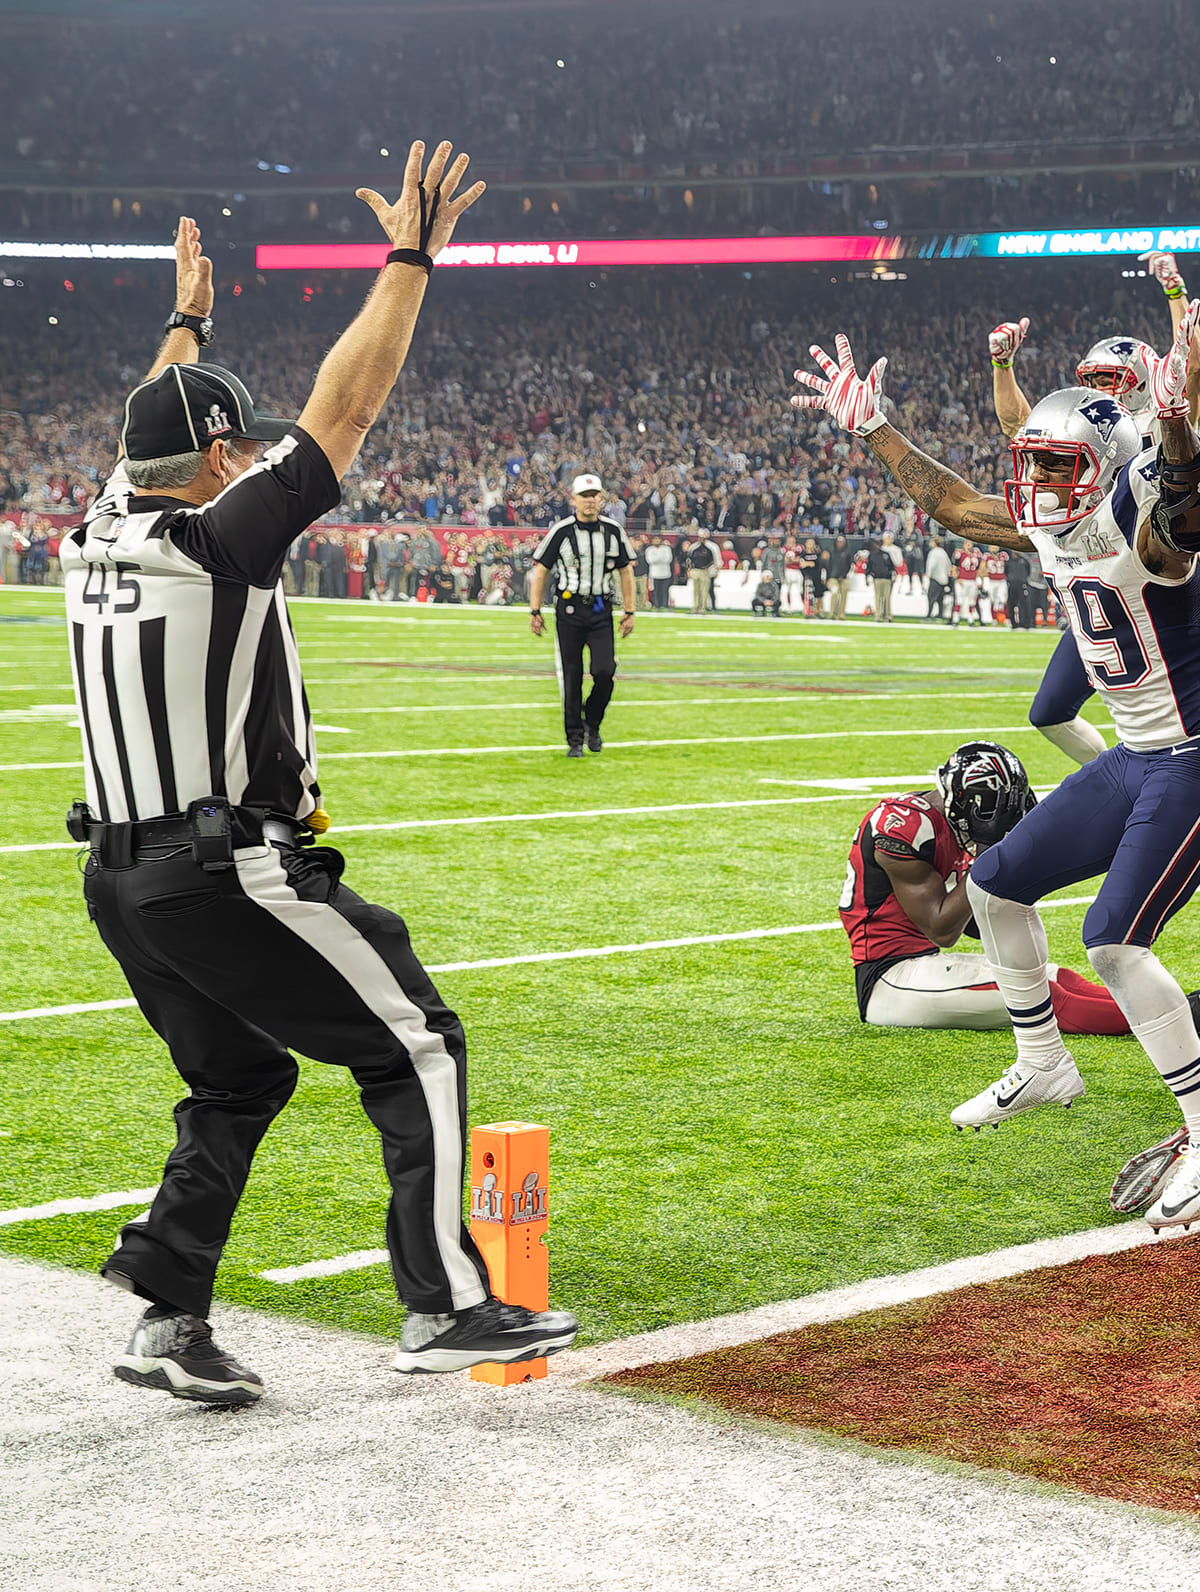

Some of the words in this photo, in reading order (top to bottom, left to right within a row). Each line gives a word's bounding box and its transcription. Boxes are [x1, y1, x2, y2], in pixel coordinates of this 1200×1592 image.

[497, 245, 554, 263] BOWL
[998, 235, 1046, 254] NEW
[1050, 231, 1154, 253] ENGLAND
[82, 562, 142, 616] 45
